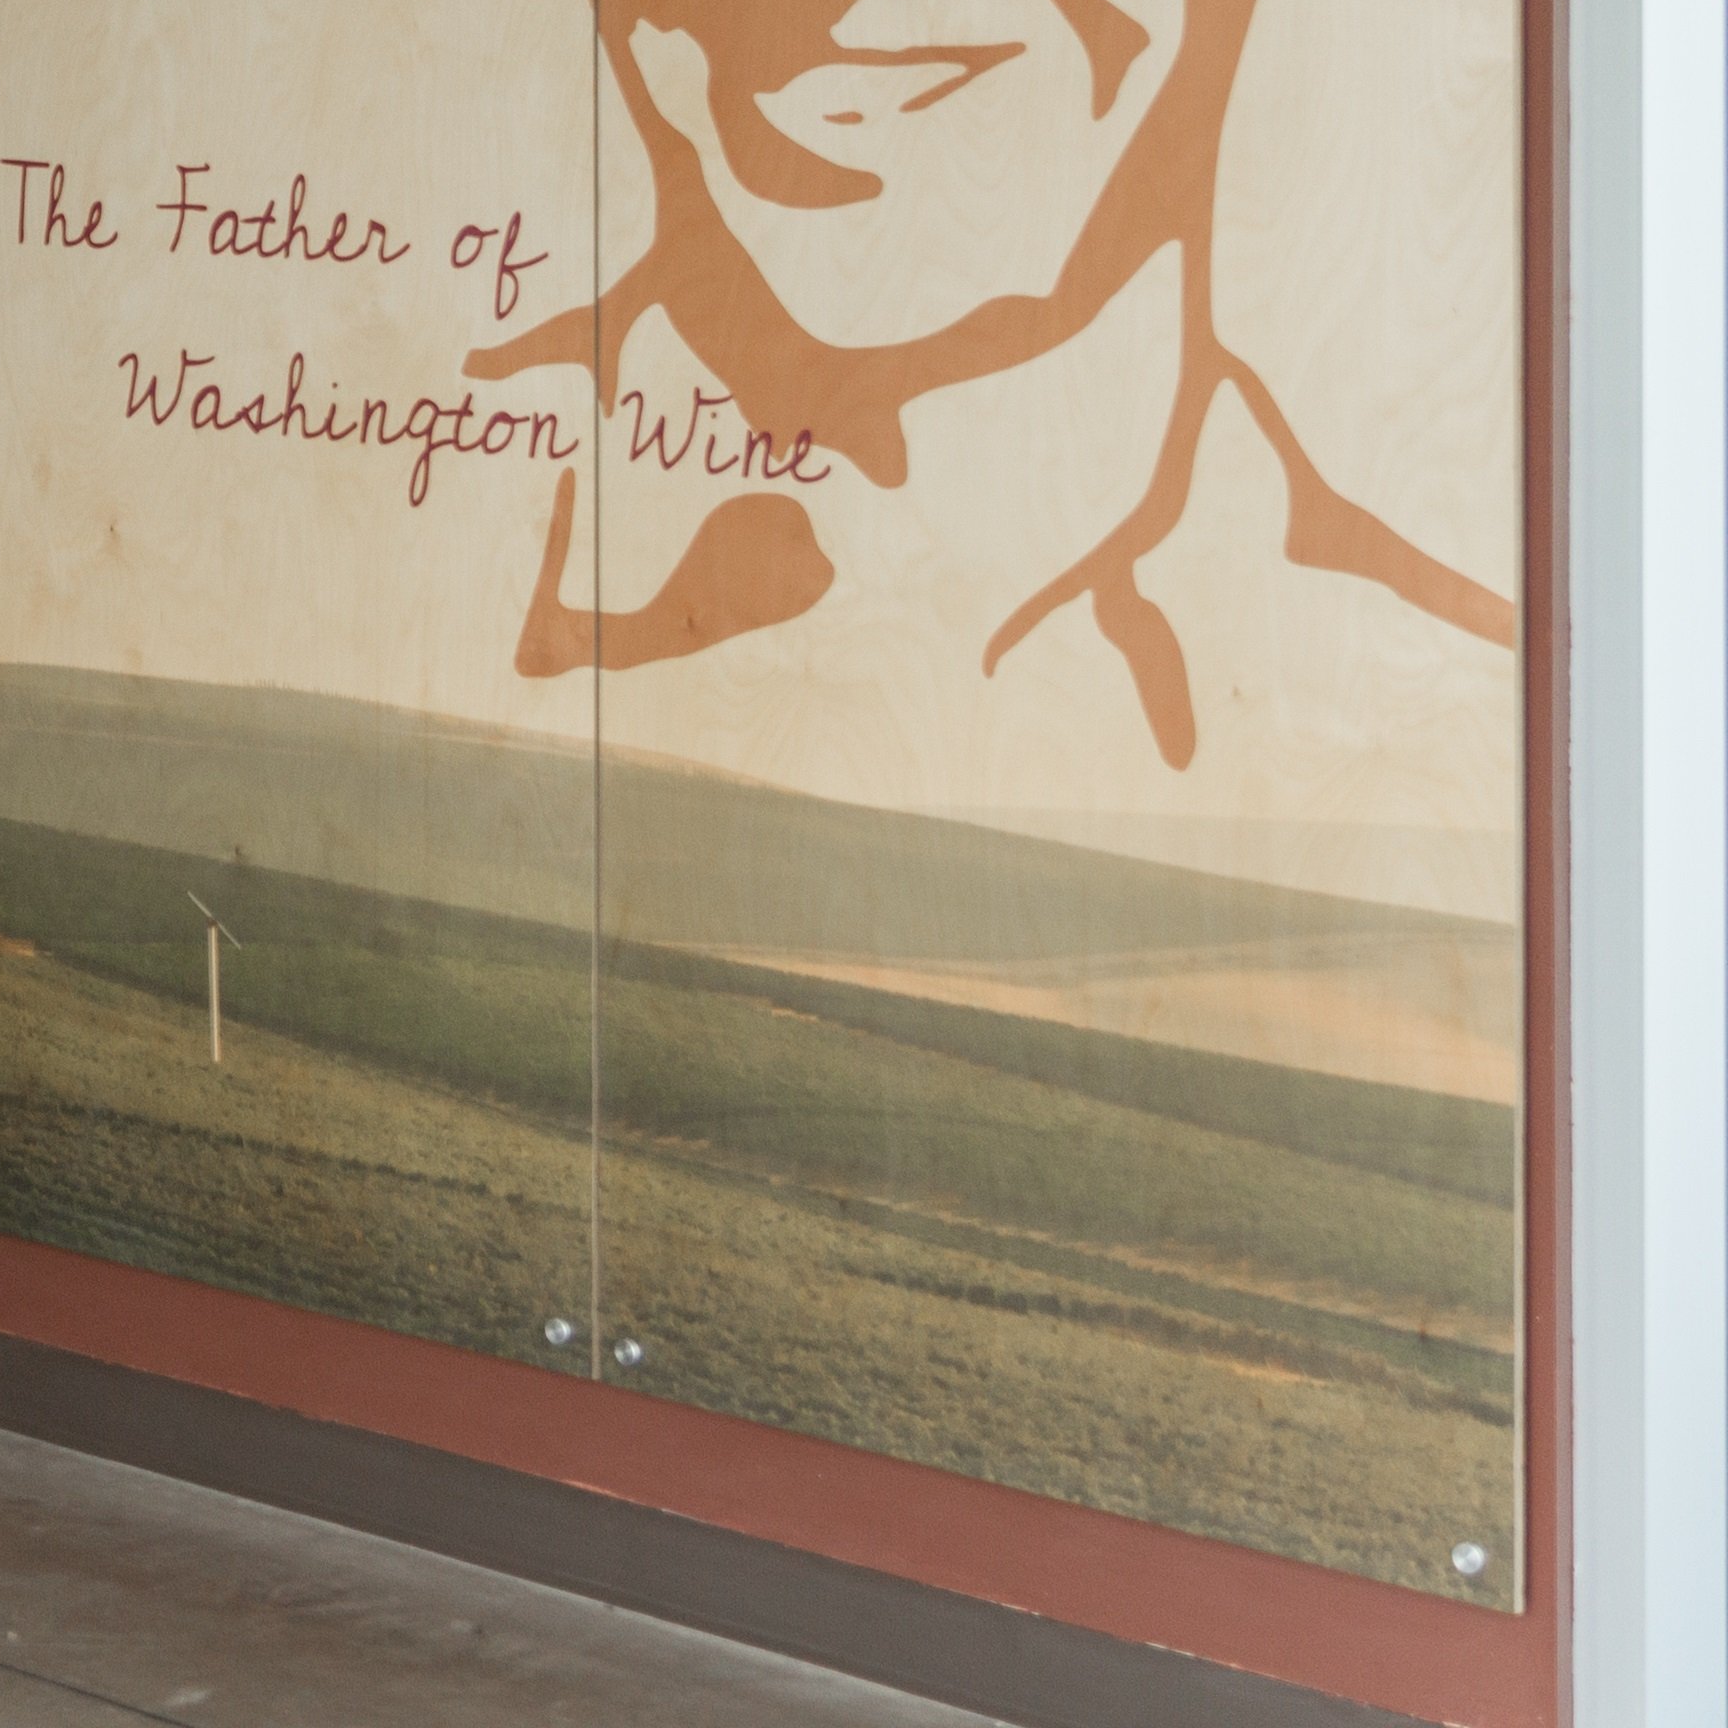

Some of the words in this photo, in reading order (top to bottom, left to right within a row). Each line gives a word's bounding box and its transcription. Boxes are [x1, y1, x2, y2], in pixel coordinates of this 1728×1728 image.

[0, 159, 118, 249] The
[157, 163, 410, 264] Father
[451, 212, 548, 320] of
[119, 349, 578, 507] Washington
[622, 387, 830, 483] Wine
